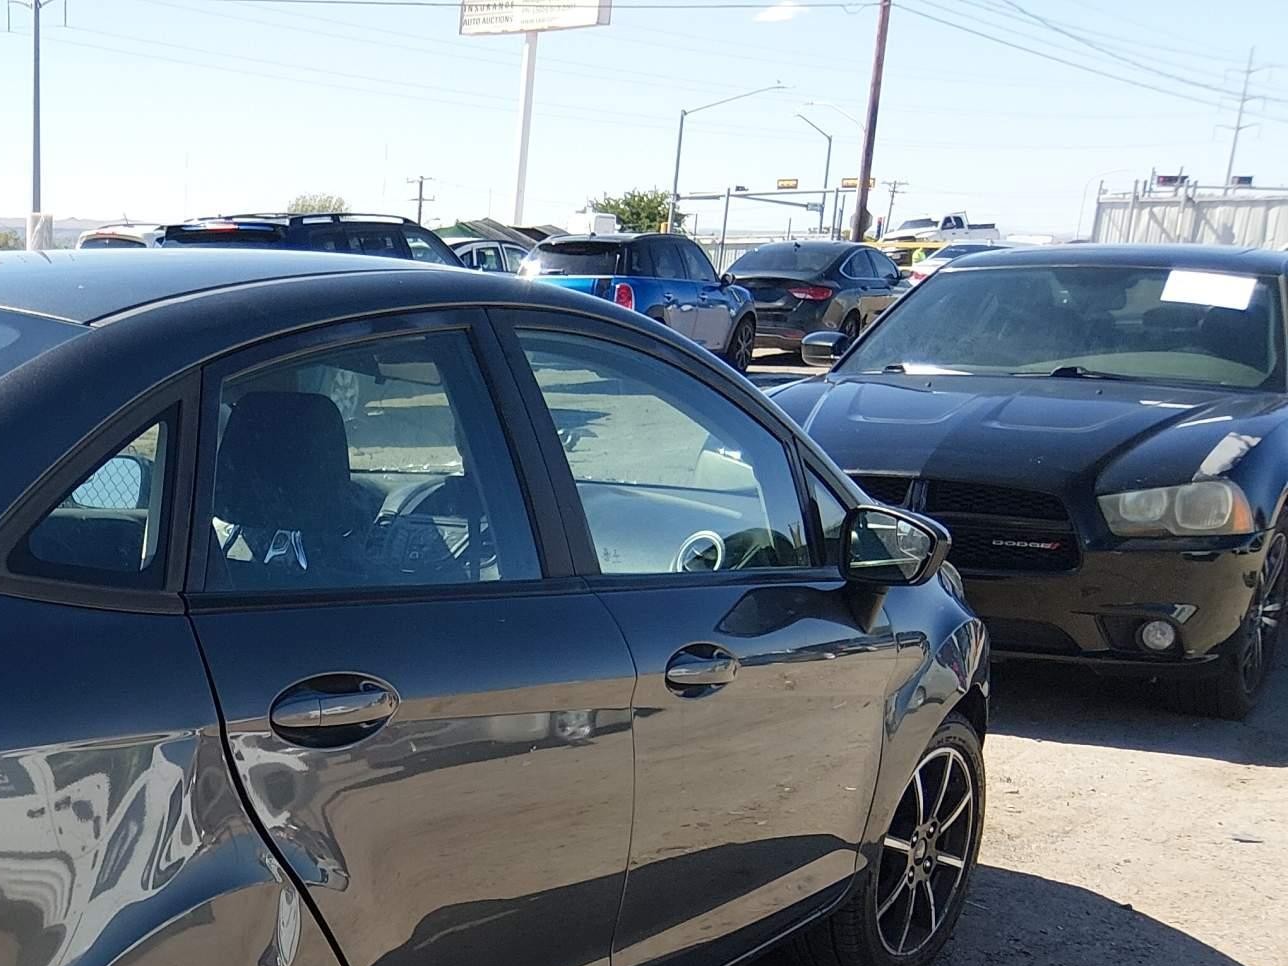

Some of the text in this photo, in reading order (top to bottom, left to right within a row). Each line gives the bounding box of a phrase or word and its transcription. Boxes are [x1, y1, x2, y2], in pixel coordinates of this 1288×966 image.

[463, 16, 480, 26] AUTO
[481, 15, 514, 25] AUCTIONS
[992, 539, 1050, 549] DODGE
